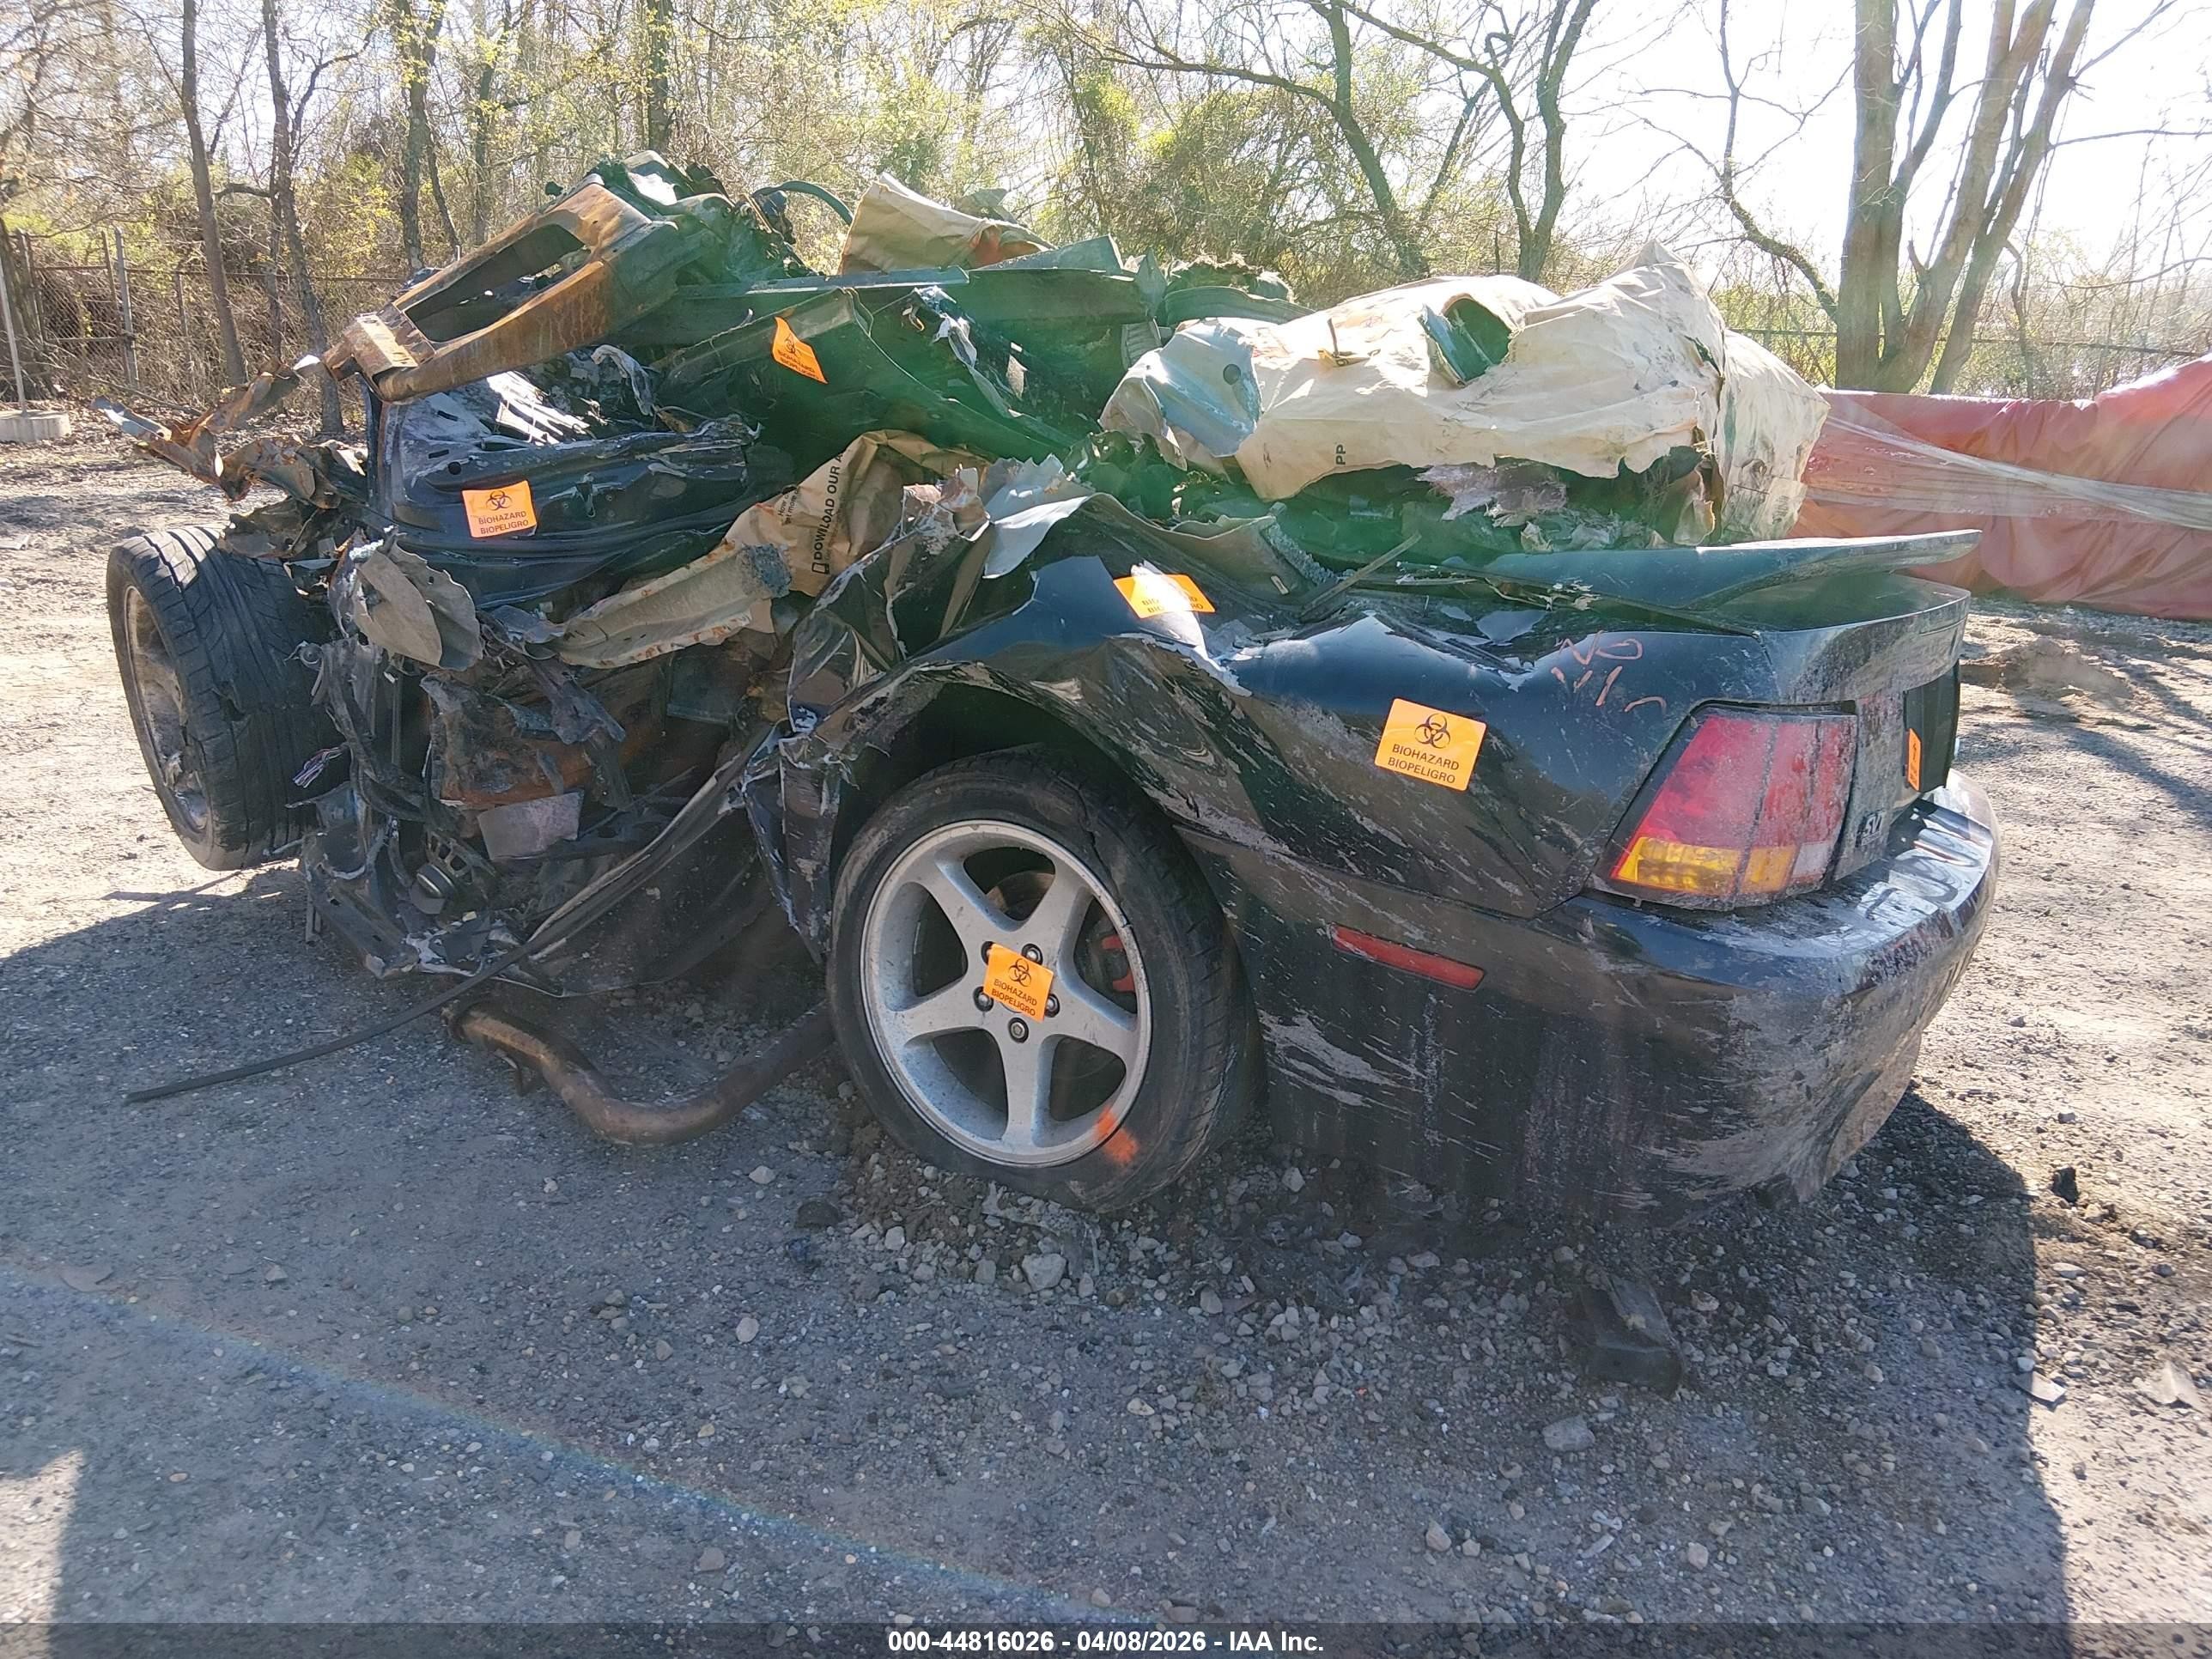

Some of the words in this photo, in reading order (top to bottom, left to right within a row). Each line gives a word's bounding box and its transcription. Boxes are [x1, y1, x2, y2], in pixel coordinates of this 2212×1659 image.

[827, 465, 842, 495] OUR
[478, 510, 527, 525] BIOHAZARD
[480, 520, 529, 534] BIOPELIGRO
[1392, 743, 1460, 770] BIOHAZARD
[1388, 757, 1455, 784] BIOPELIGRO
[991, 988, 1036, 1016] BIOPELIGRO
[994, 978, 1037, 1006] BIOHAZARD
